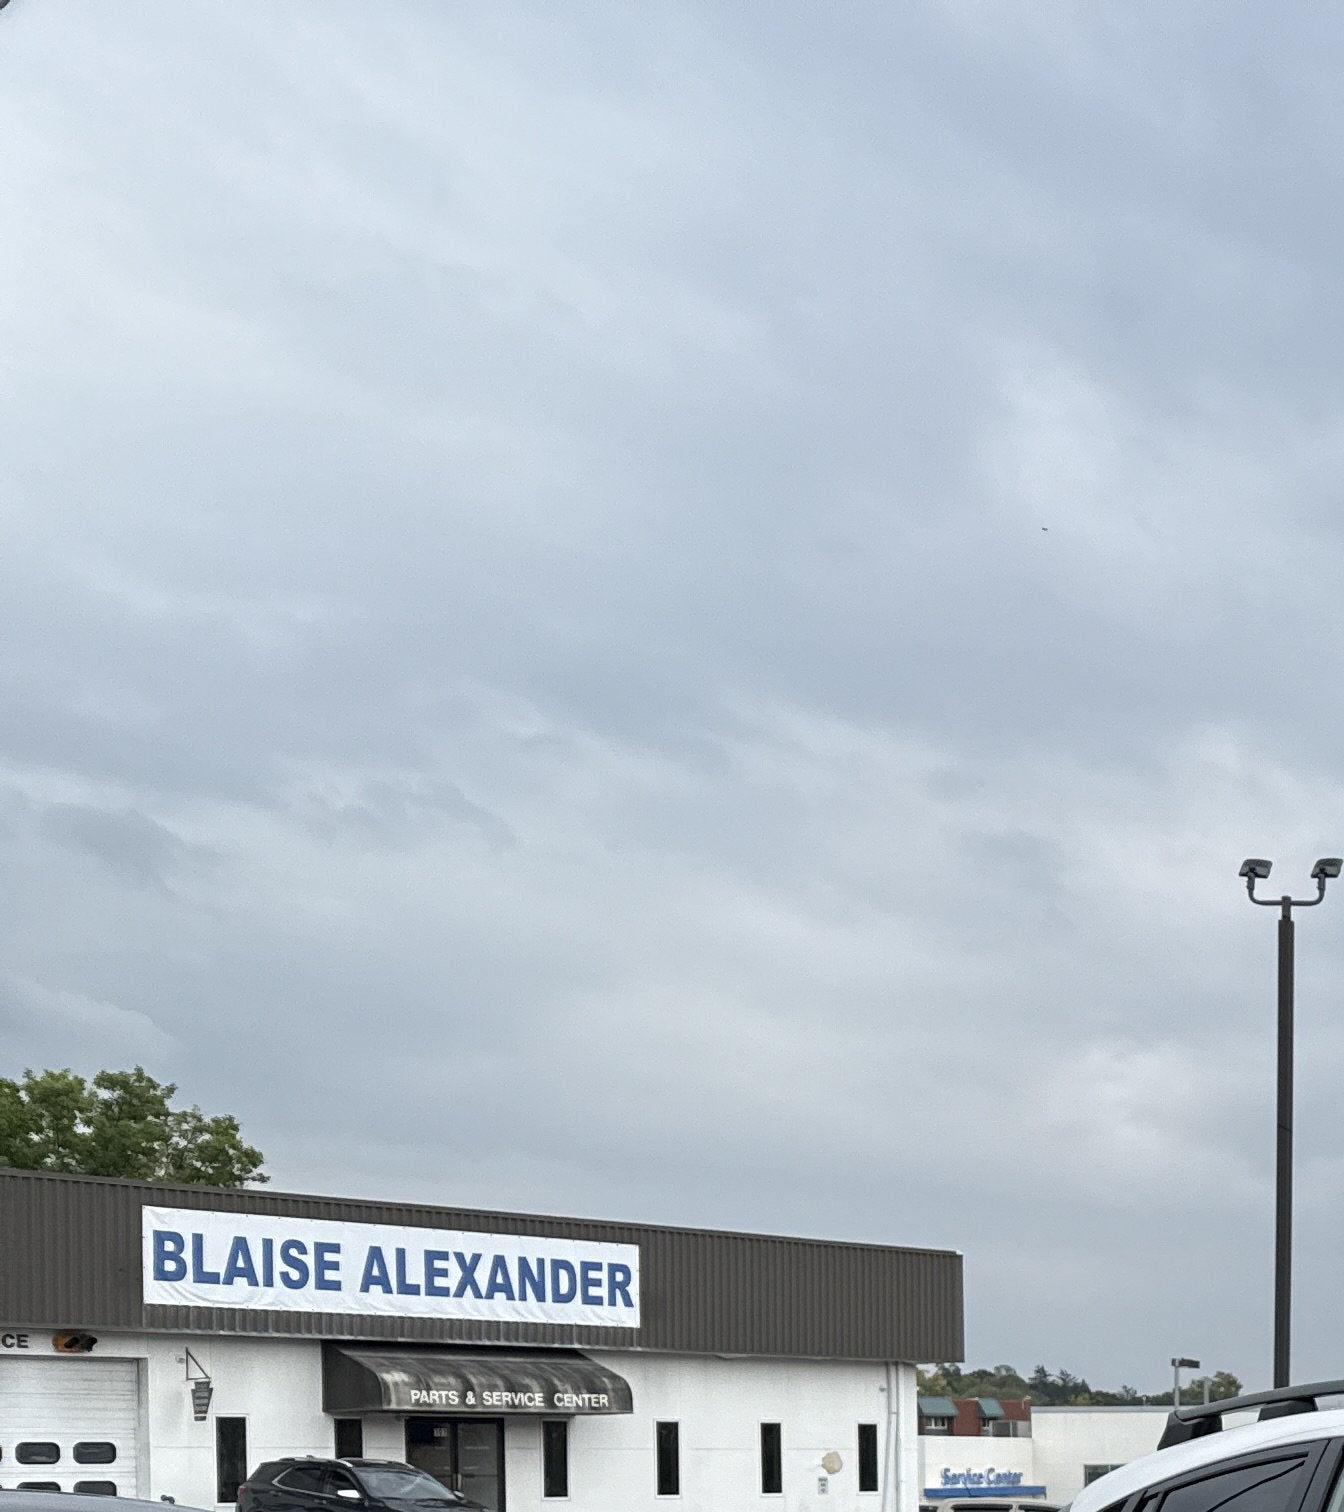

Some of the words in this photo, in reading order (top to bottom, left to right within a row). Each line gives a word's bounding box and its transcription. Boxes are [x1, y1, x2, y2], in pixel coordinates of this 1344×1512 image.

[152, 1228, 343, 1291] BLAISE
[358, 1244, 635, 1308] ALEXANDER
[410, 1389, 459, 1406] PARTS
[465, 1390, 477, 1406] &
[482, 1391, 545, 1407] SERVICE
[553, 1392, 609, 1408] CENTER
[941, 1467, 984, 1486] Service
[986, 1467, 1024, 1486] Center
